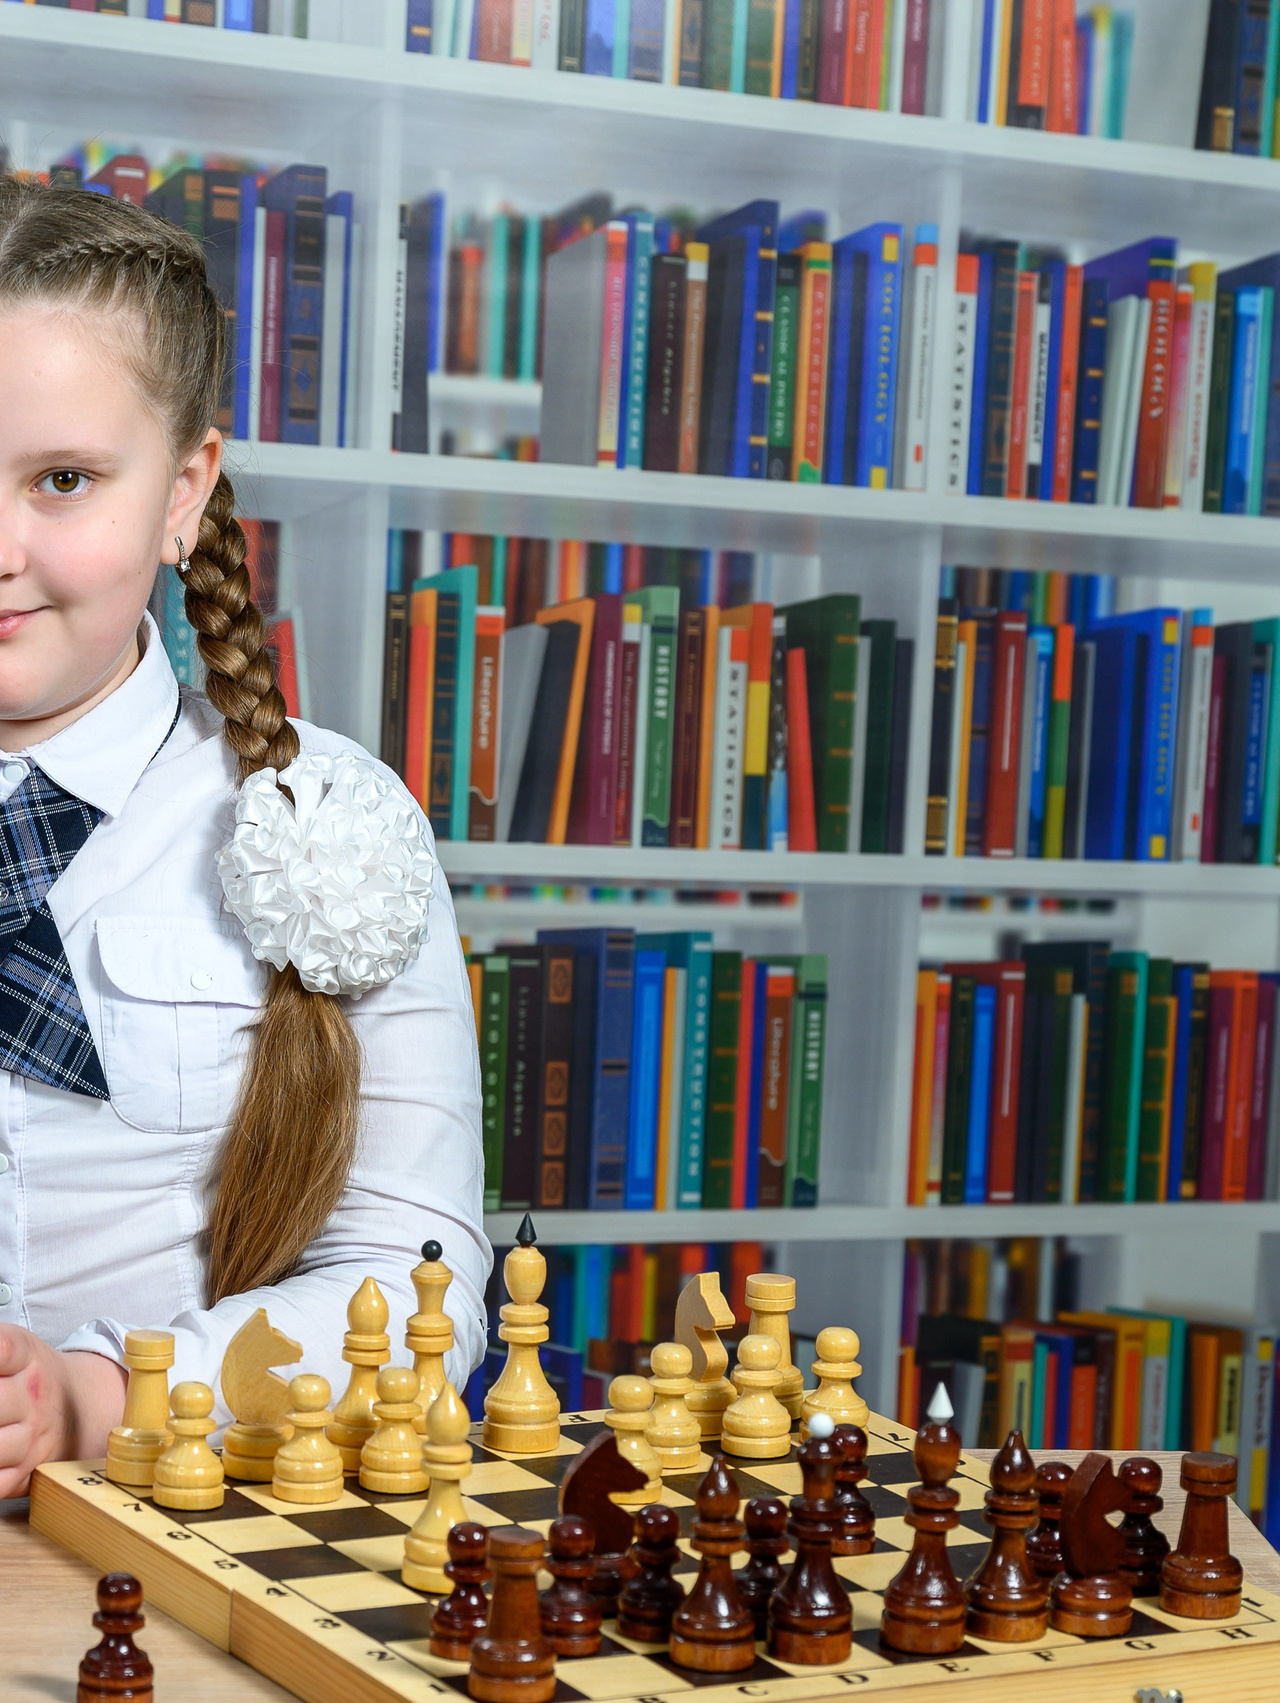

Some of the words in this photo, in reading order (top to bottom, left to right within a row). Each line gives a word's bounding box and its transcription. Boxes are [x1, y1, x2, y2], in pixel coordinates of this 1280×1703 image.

[630, 256, 649, 450] CONSTRUCTION
[874, 271, 895, 428] SOCIOLOGY
[948, 301, 969, 487] STATISTICS
[654, 645, 671, 720] HISTORY
[477, 656, 496, 750] Literature
[723, 668, 741, 839] STATISTICS
[804, 1010, 822, 1082] HISTORY
[767, 1017, 786, 1111] Literature
[687, 975, 709, 1177] CONSTRUCTION
[76, 1476, 104, 1487] 8
[122, 1502, 144, 1513] 7
[166, 1530, 193, 1541] 6
[213, 1558, 240, 1571] 5
[266, 1586, 291, 1598] 4
[313, 1618, 342, 1630] 3
[1217, 1628, 1258, 1640] H
[1124, 1640, 1157, 1651] G
[366, 1650, 397, 1662] 2
[1031, 1651, 1057, 1663] F
[933, 1661, 970, 1674] E
[836, 1673, 871, 1686] D
[737, 1685, 768, 1697] C
